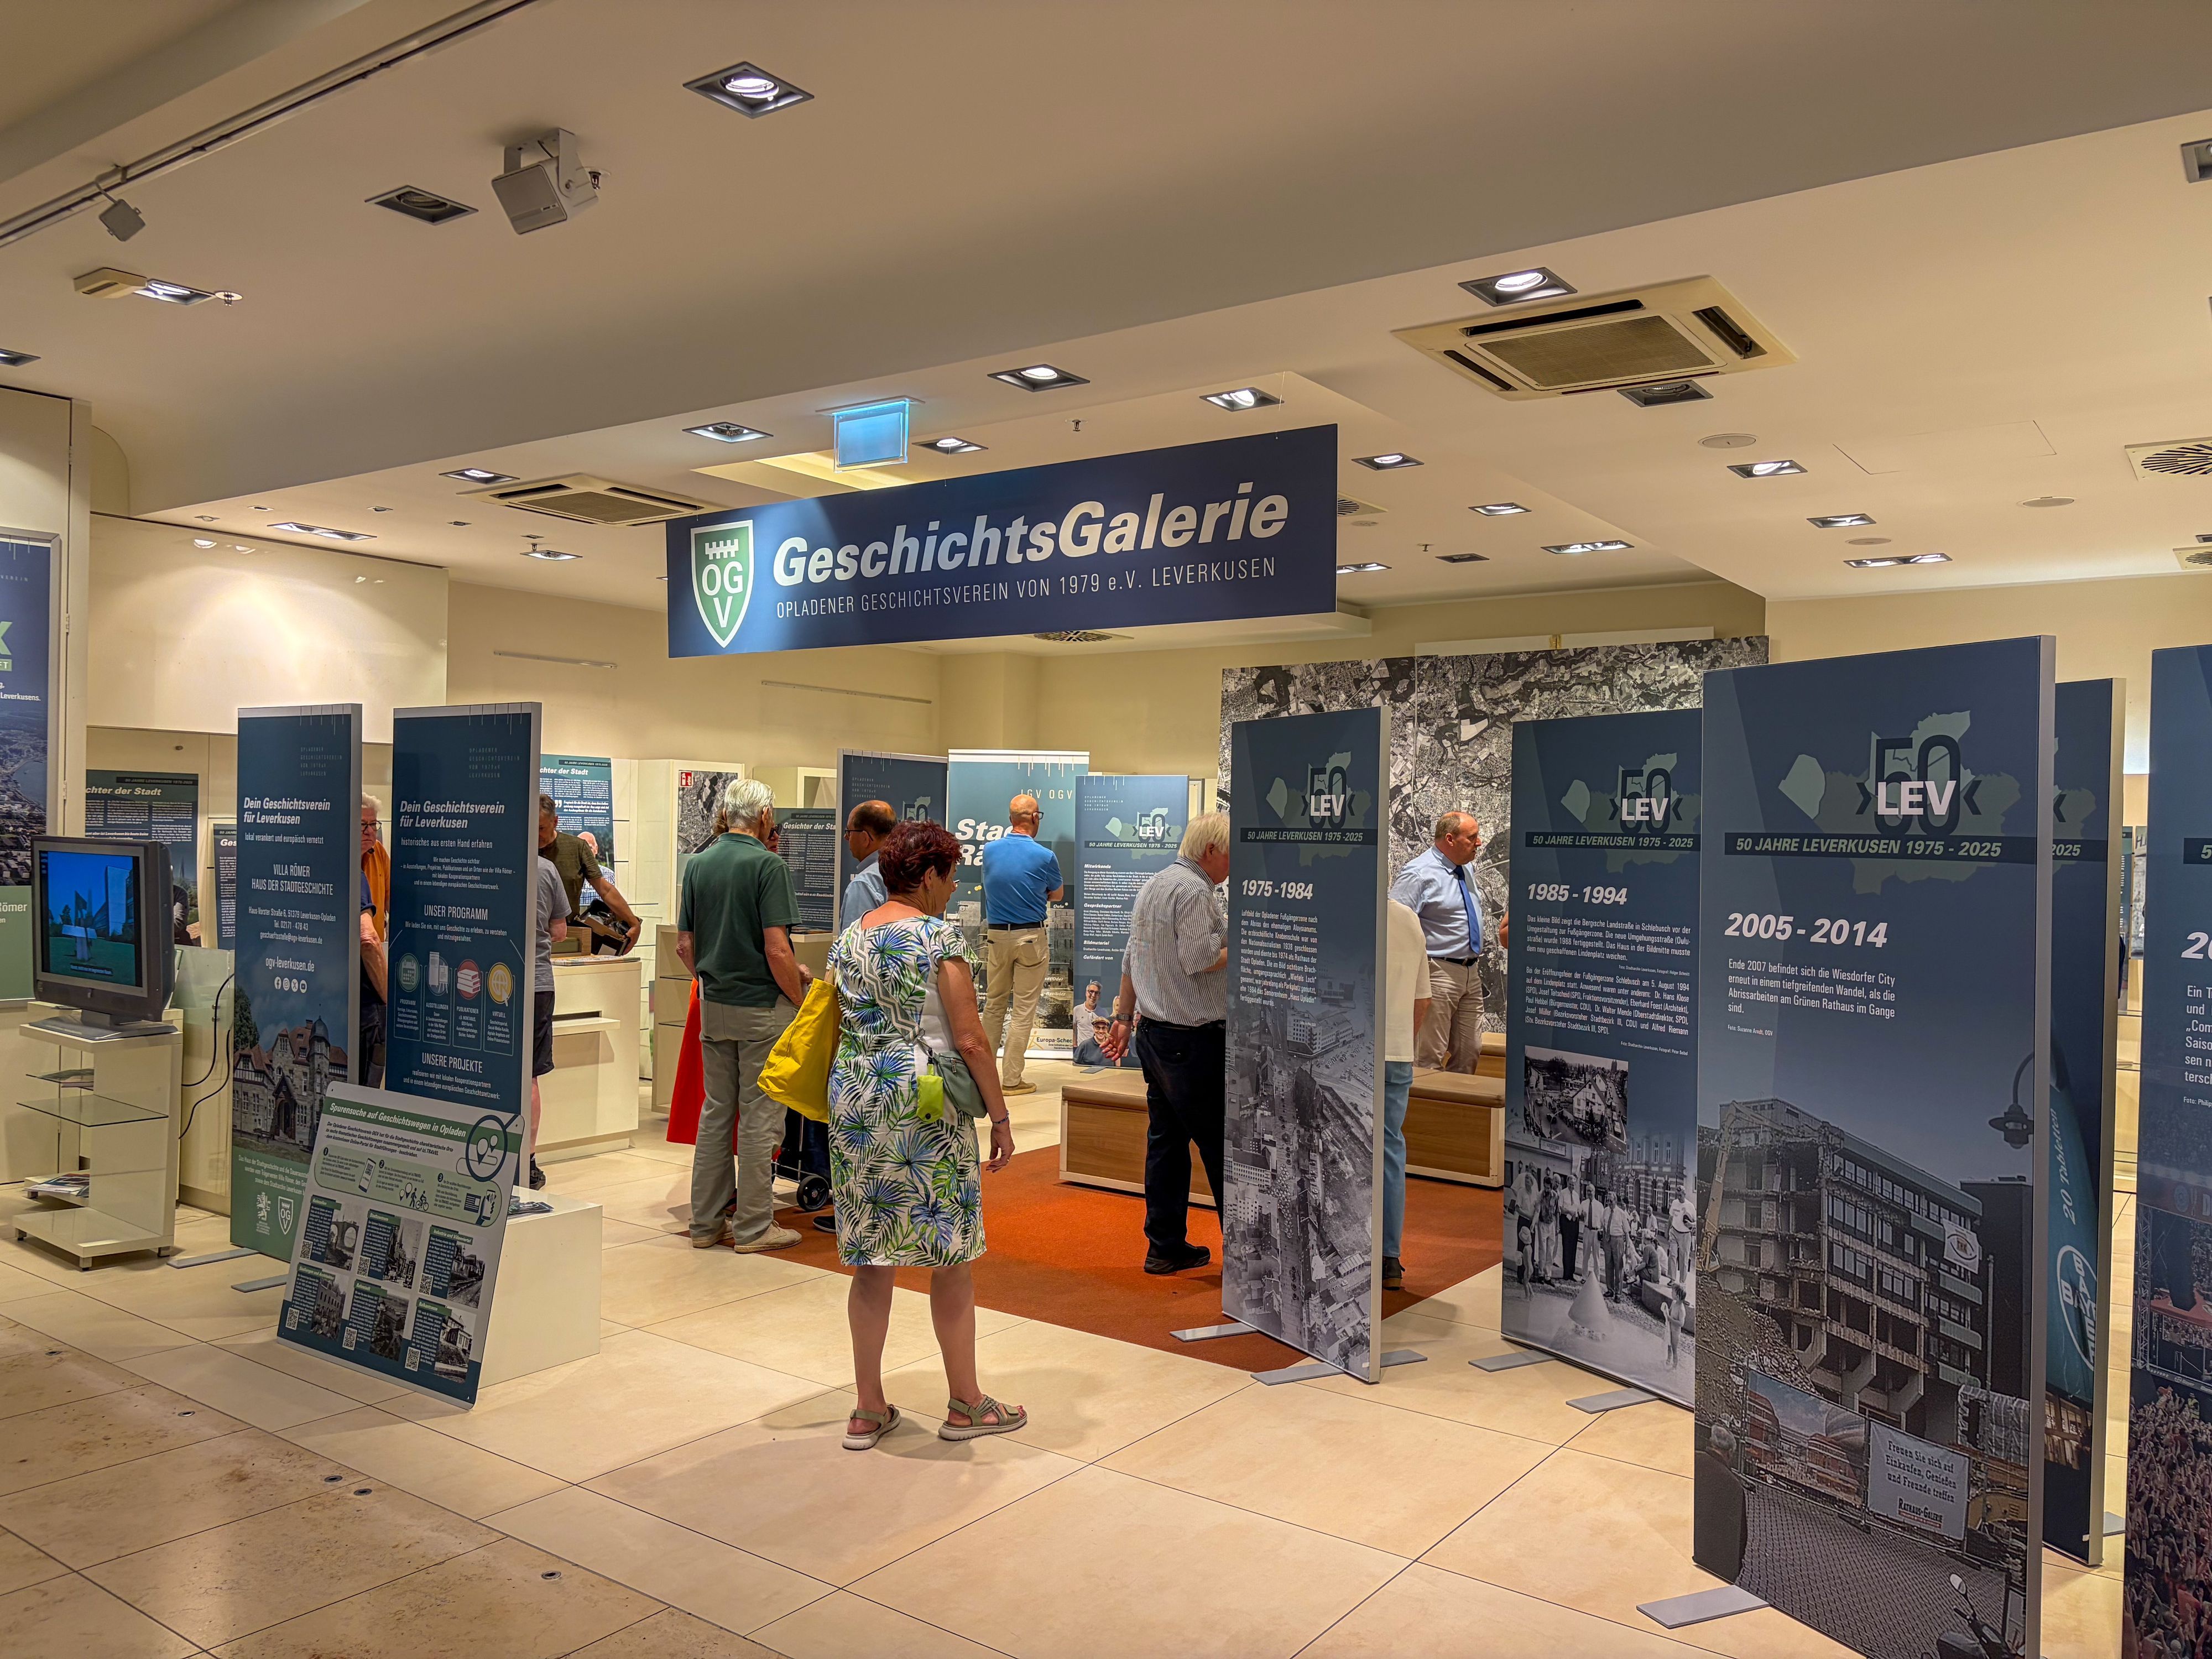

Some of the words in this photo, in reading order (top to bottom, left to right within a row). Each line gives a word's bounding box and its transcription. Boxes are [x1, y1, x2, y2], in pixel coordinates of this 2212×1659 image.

[773, 482, 1289, 586] GeschichtsGalerie
[776, 596, 854, 618] OPLADENER
[861, 583, 1009, 612] GESCHICHTSVEREIN
[1017, 578, 1050, 598] VON
[1060, 574, 1100, 594] 1979
[1108, 570, 1141, 590] e.V.
[1153, 557, 1275, 587] LEVERKUSEN
[1, 692, 41, 701] Leverkusens.
[134, 787, 162, 796] Stadt
[1049, 790, 1073, 800] OGV
[1877, 780, 1957, 815] LEV
[243, 797, 261, 808] Dein
[263, 797, 331, 811] Geschichtsverein
[399, 800, 420, 812] Dein
[423, 801, 505, 813] Geschichtsverein
[1310, 794, 1345, 816] LEV
[1621, 797, 1668, 821] LEV
[243, 811, 254, 823] für
[257, 812, 300, 824] Leverkusen
[399, 815, 413, 827] für
[415, 816, 468, 828] Leverkusen
[245, 832, 254, 841] lokal
[255, 833, 274, 842] verankert
[283, 834, 305, 845] europäisch
[306, 836, 324, 844] vernetzt
[1139, 826, 1164, 837] LEV
[1248, 831, 1255, 839] 50
[1256, 831, 1276, 840] JAHRE
[1279, 832, 1322, 841] LEVERKUSEN
[1325, 832, 1340, 841] 1975
[401, 837, 429, 847] historisches
[440, 838, 456, 847] ersten
[457, 838, 469, 848] Hand
[471, 839, 493, 848] erfahren
[1533, 836, 1543, 844] 50
[1545, 836, 1573, 845] JAHRE
[1575, 836, 1635, 847] LEVERKUSEN
[1639, 837, 1660, 847] 1975
[1668, 837, 1693, 848] 2025
[1736, 838, 1752, 851] 50
[1755, 838, 1798, 852] JAHRE
[1802, 839, 1900, 854] LEVERKUSEN
[1907, 841, 1943, 855] 1975
[1958, 842, 2002, 857] 2025
[273, 864, 288, 875] VILLA
[290, 864, 310, 877] RÖMER
[252, 878, 266, 890] HAUS
[268, 879, 278, 891] DER
[280, 880, 333, 895] STADTGESCHICHTE
[424, 905, 445, 917] UNSER
[447, 906, 488, 920] PROGRAMM
[1561, 917, 1572, 927] zeigt
[1582, 919, 1605, 929] Bergische
[1606, 921, 1634, 930] Landstraße
[1641, 923, 1670, 932] Schlebusch
[265, 957, 315, 972] ogv-leverkusen.de
[1729, 958, 1745, 969] Ende
[1747, 960, 1766, 972] 2007
[1768, 962, 1797, 975] befindet
[1801, 966, 1815, 977] sich
[1818, 967, 1829, 978] die
[1832, 968, 1874, 983] Wiesdorfer
[1878, 973, 1895, 987] City
[1729, 974, 1750, 985] erneut
[1752, 977, 1757, 986] in
[1760, 977, 1780, 988] einem
[1782, 979, 1833, 996] tiefgreifenden
[1836, 985, 1867, 999] Wandel,
[1869, 988, 1880, 999] als
[1882, 989, 1895, 1001] die
[2187, 985, 2202, 998] Ein
[1728, 1002, 1744, 1013] sind.
[1729, 987, 1778, 1003] Abrissarbeiten
[1780, 995, 1791, 1004] am
[1793, 994, 1819, 1008] Grünen
[1822, 998, 1854, 1012] Rathaus
[1856, 1001, 1866, 1014] im
[1869, 1003, 1895, 1019] Gange
[2187, 1004, 2205, 1015] und
[422, 1052, 446, 1067] UNSERE
[448, 1056, 483, 1073] PROJEKTE
[2185, 1056, 2202, 1066] sen
[330, 1104, 366, 1120] Spurensuche
[367, 1110, 377, 1120] auf
[378, 1113, 431, 1132] Geschichtswegen
[431, 1123, 438, 1132] in
[440, 1124, 466, 1139] Opladen
[1888, 1440, 1913, 1459] Freuen
[1914, 1449, 1925, 1463] Sie
[1928, 1454, 1941, 1469] sich
[1943, 1459, 1954, 1473] auf
[1886, 1454, 1925, 1479] Einkaufen,
[1926, 1468, 1957, 1489] Genießen
[1887, 1471, 1901, 1484] und
[1903, 1477, 1931, 1495] Freunde
[1933, 1487, 1954, 1503] treffen
